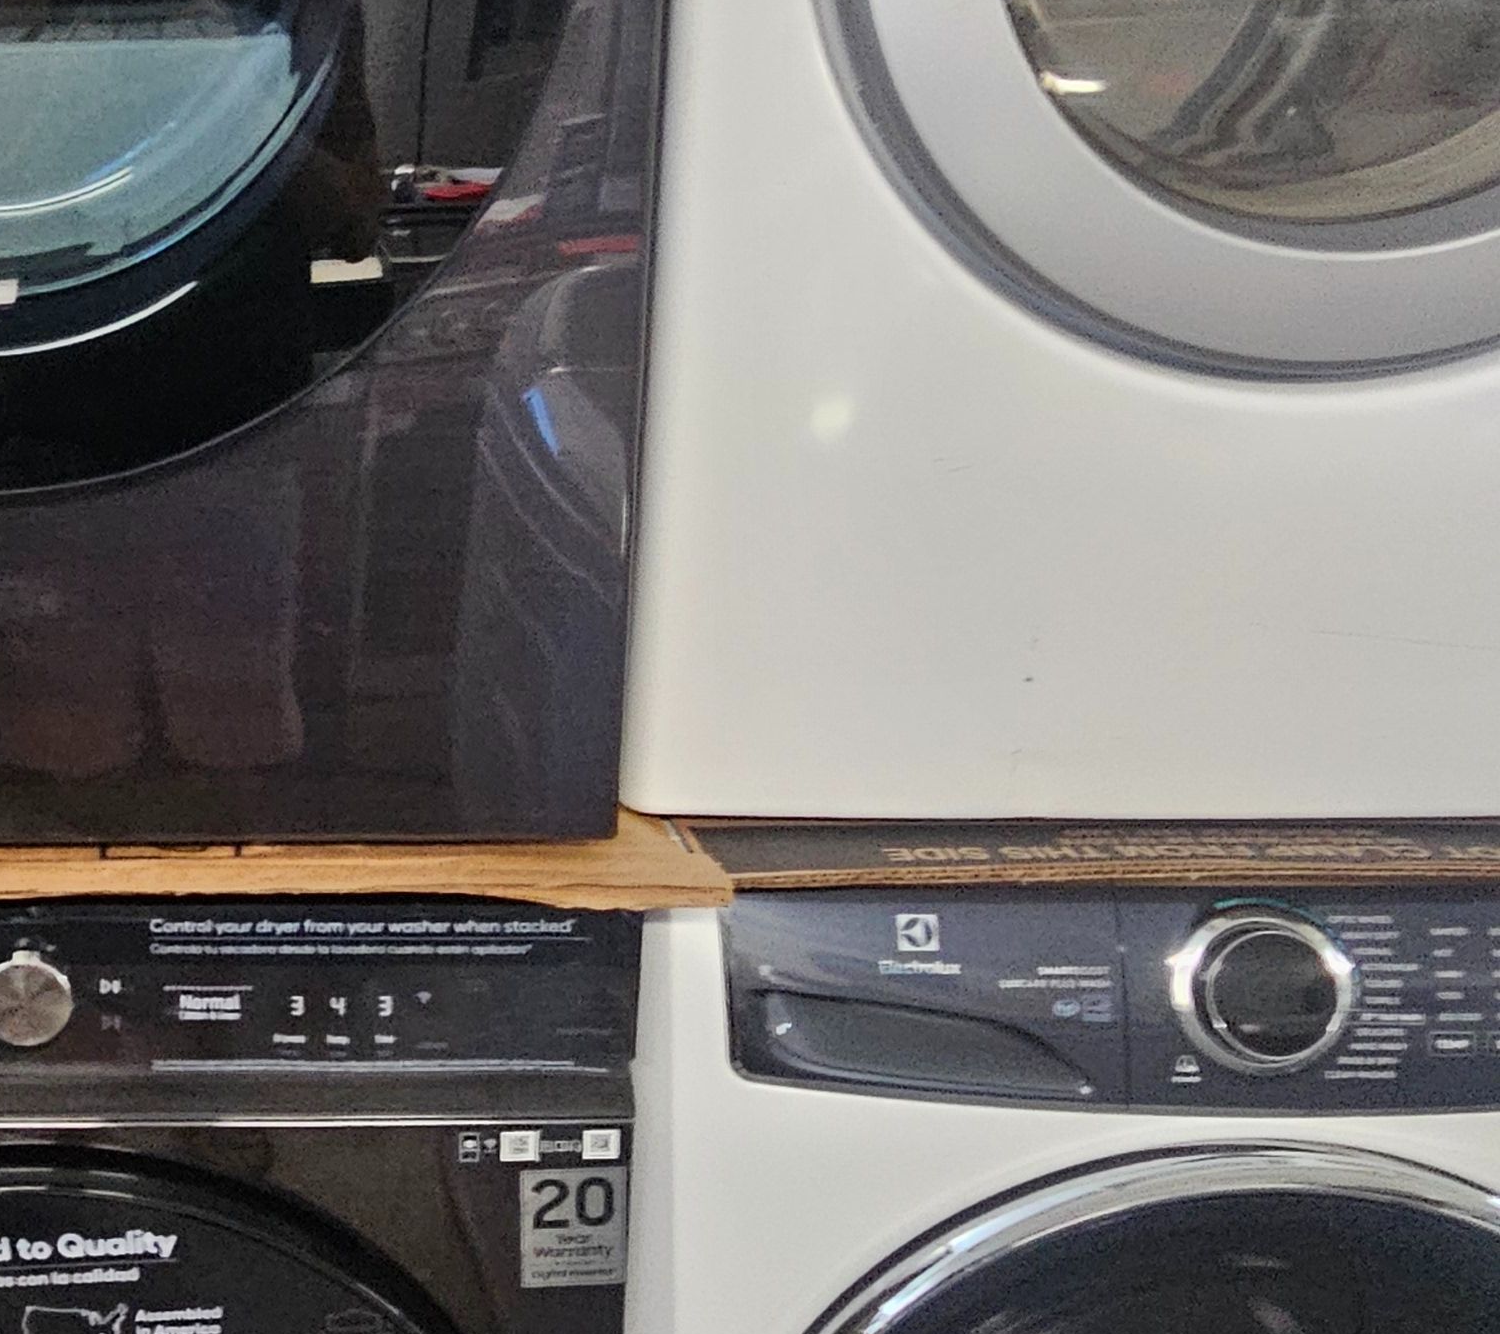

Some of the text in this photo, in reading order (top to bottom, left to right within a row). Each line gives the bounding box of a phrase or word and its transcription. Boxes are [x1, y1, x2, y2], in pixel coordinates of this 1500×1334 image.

[882, 844, 992, 862] SIDE
[999, 844, 1111, 861] THIS
[149, 918, 214, 934] Control
[214, 921, 253, 936] your
[254, 918, 301, 936] dryer
[303, 918, 346, 934] from
[346, 921, 386, 936] your
[387, 919, 451, 934] washer
[452, 918, 502, 934] when
[178, 993, 394, 1017] Normal 3 4 3
[530, 1176, 616, 1230] 20
[15, 1238, 53, 1261] to
[55, 1229, 178, 1259] Quality
[532, 1245, 615, 1259] Warranty
[134, 1305, 224, 1323] Assembled
